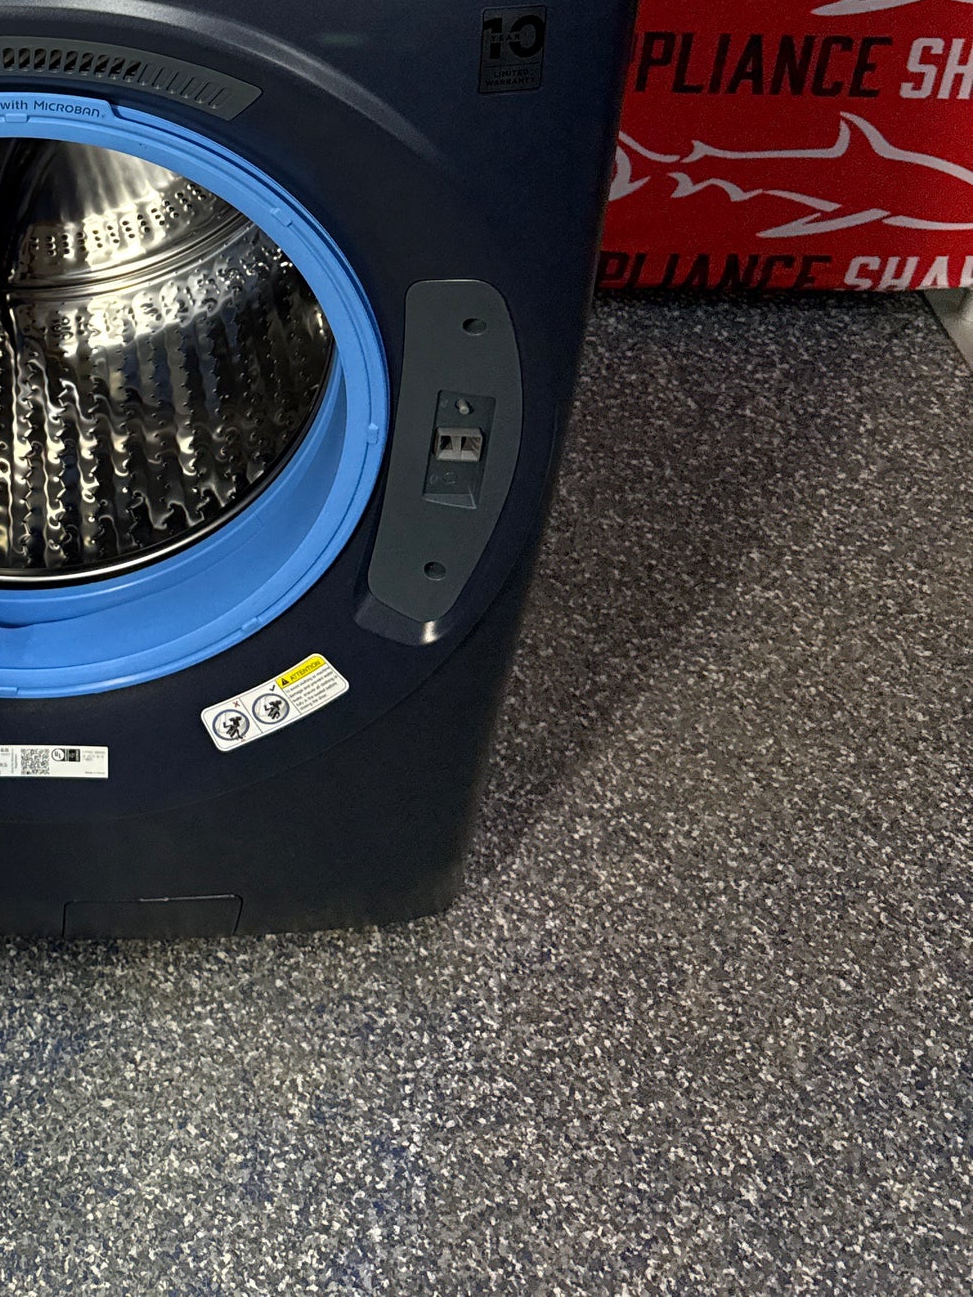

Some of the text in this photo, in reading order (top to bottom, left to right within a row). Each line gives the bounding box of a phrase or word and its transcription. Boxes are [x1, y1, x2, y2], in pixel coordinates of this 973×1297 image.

[483, 14, 545, 60] 10
[0, 99, 28, 110] with
[290, 660, 321, 681] ATTENTION
